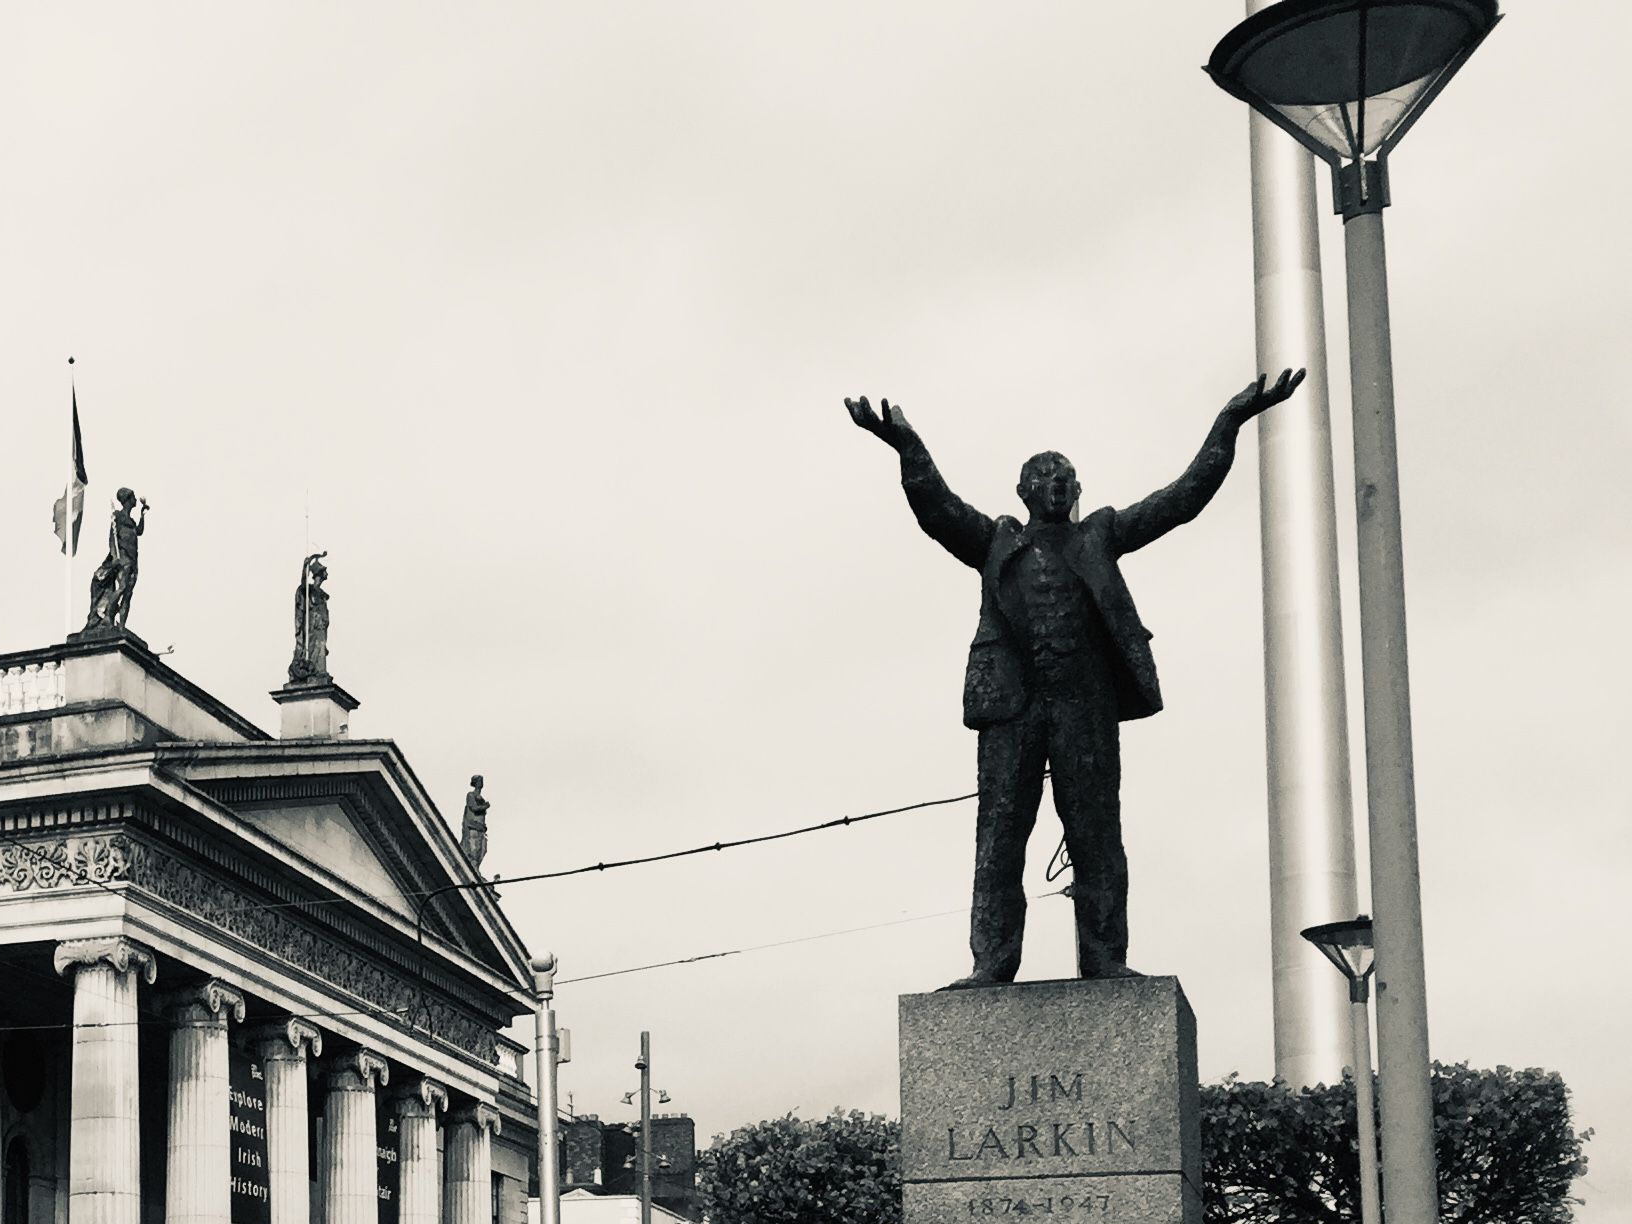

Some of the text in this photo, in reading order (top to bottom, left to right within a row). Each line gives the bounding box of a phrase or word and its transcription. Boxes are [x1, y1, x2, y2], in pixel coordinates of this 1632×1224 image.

[998, 1073, 1083, 1110] JIM
[947, 1120, 1137, 1160] LARKIN
[238, 1147, 262, 1167] Irish
[230, 1176, 268, 1202] History
[967, 1194, 1111, 1216] 1874-1947
